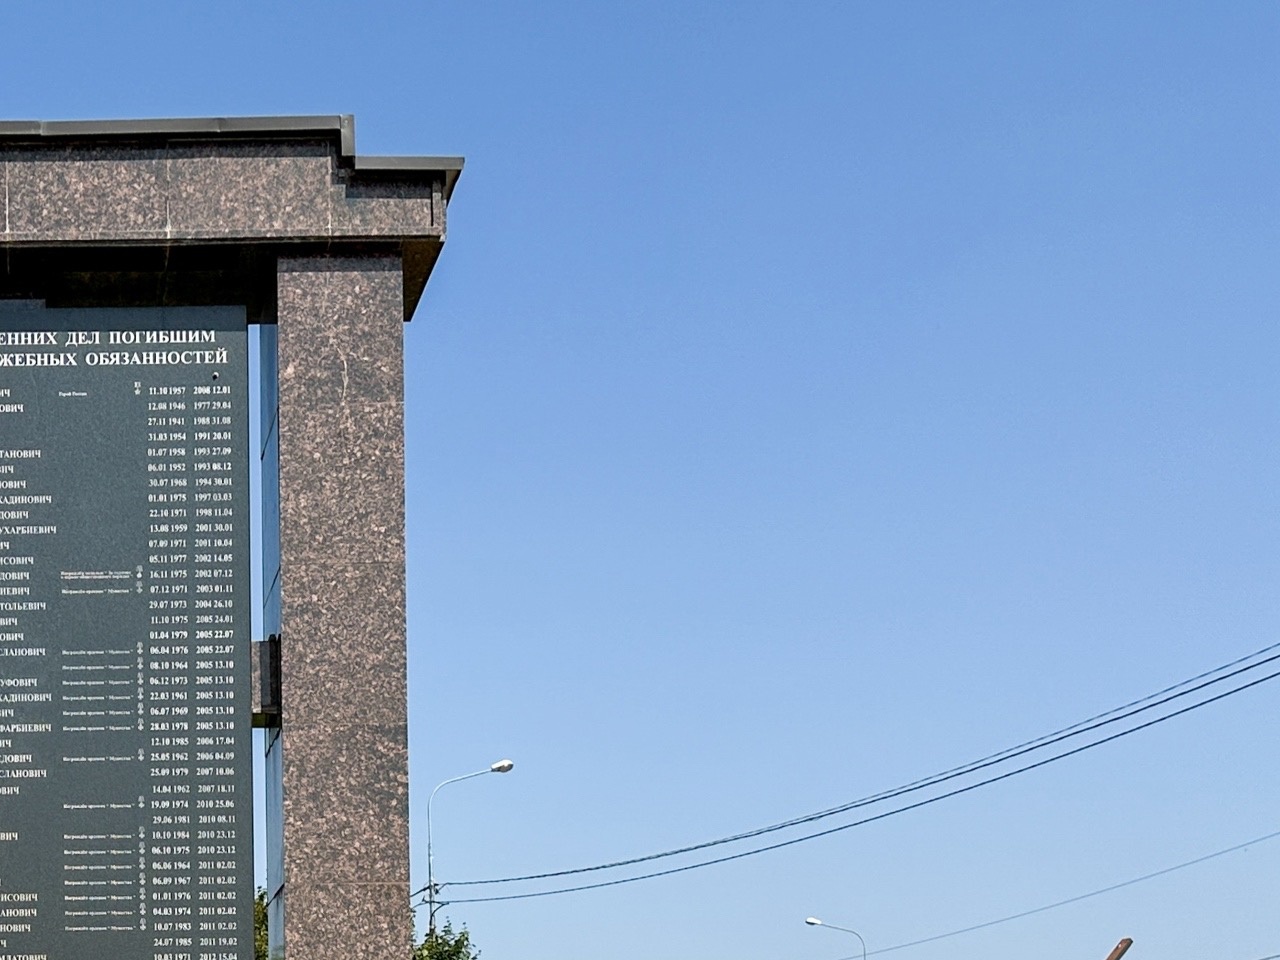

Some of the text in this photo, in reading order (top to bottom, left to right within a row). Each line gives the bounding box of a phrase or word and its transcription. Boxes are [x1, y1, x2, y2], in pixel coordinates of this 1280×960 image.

[65, 331, 100, 347] ДЕЛ
[109, 330, 215, 344] ПОГИБШИМ
[85, 347, 228, 366] ОБЯЗАННОСТЕЙ
[148, 492, 232, 503] 01.01 1975 1997 03.03
[151, 736, 235, 747] 12.10 1985 2006 17.04
[151, 799, 235, 809] 19.09 1974 2010 25.06
[152, 829, 236, 840] 10.10 1984 2010 23.12
[154, 937, 238, 947] 24.07 1985 2011 19.02
